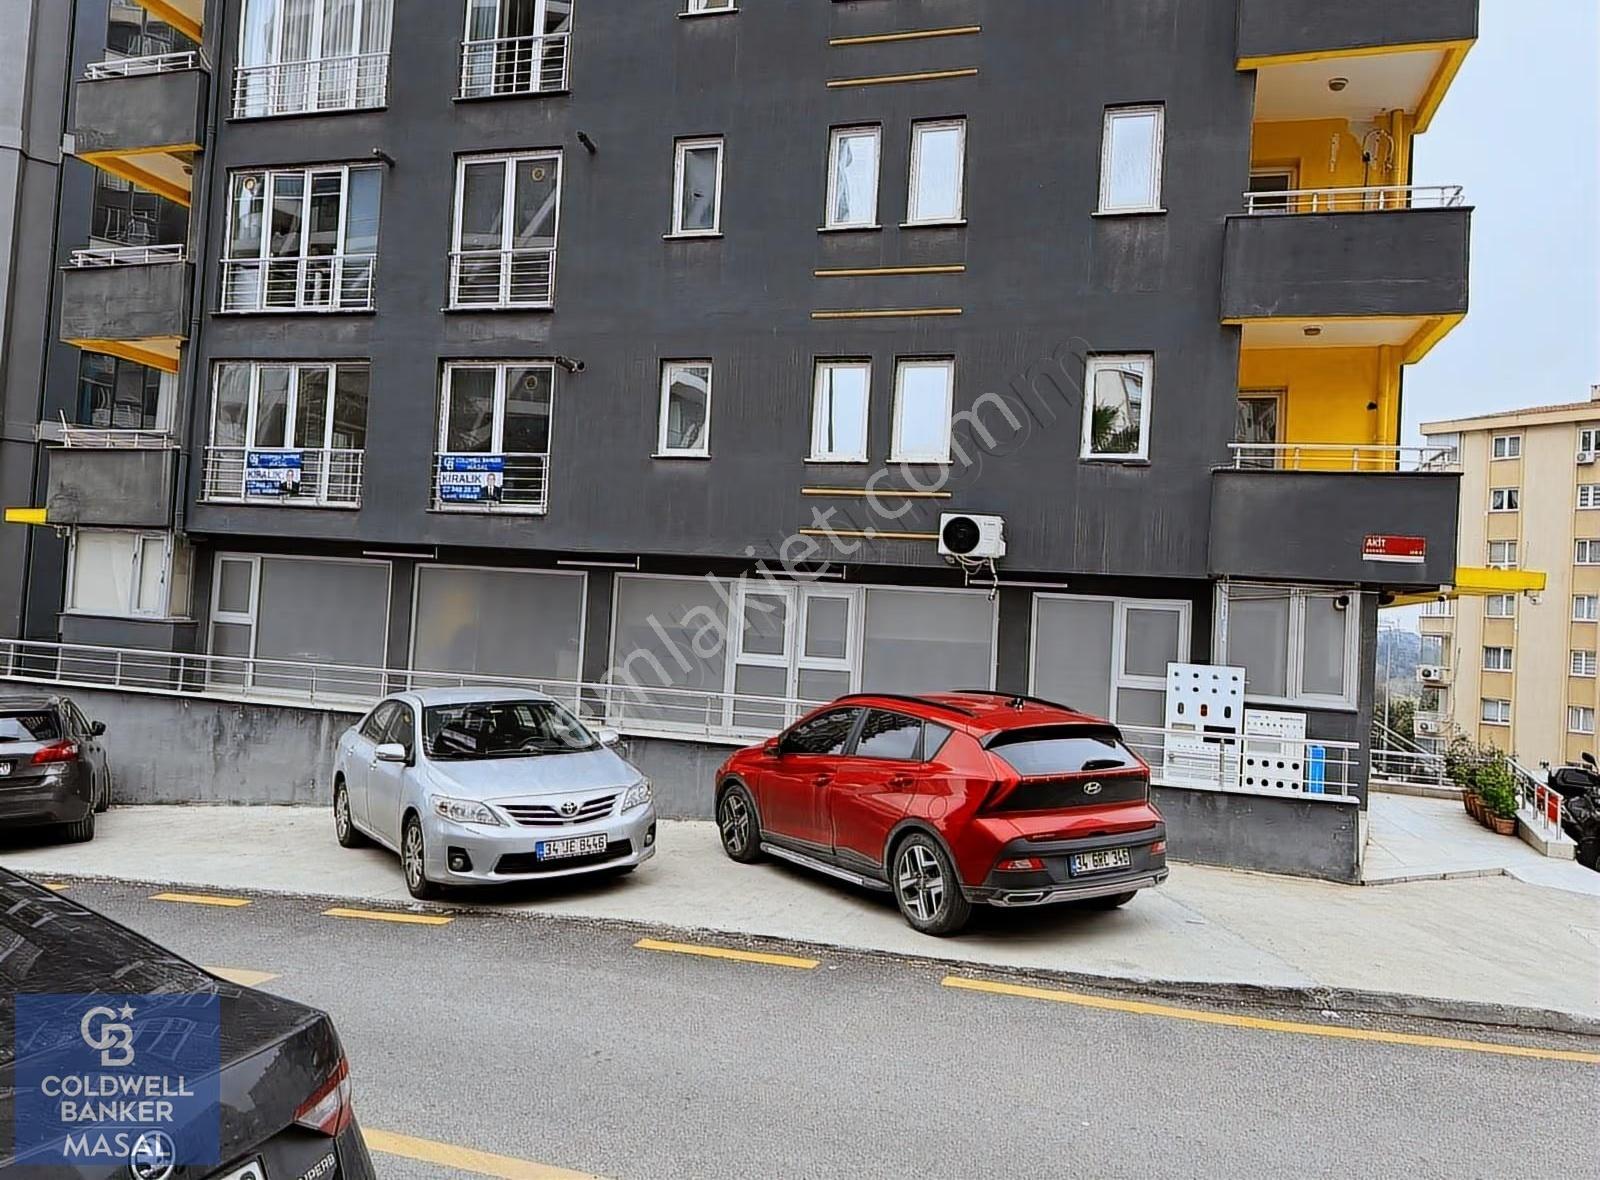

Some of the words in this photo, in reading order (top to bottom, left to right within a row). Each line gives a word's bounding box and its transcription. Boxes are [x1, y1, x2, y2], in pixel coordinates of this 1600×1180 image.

[248, 470, 285, 480] KIRALIK
[442, 474, 481, 484] KIRALIK
[545, 842, 559, 856] 34
[1076, 854, 1088, 870] 34
